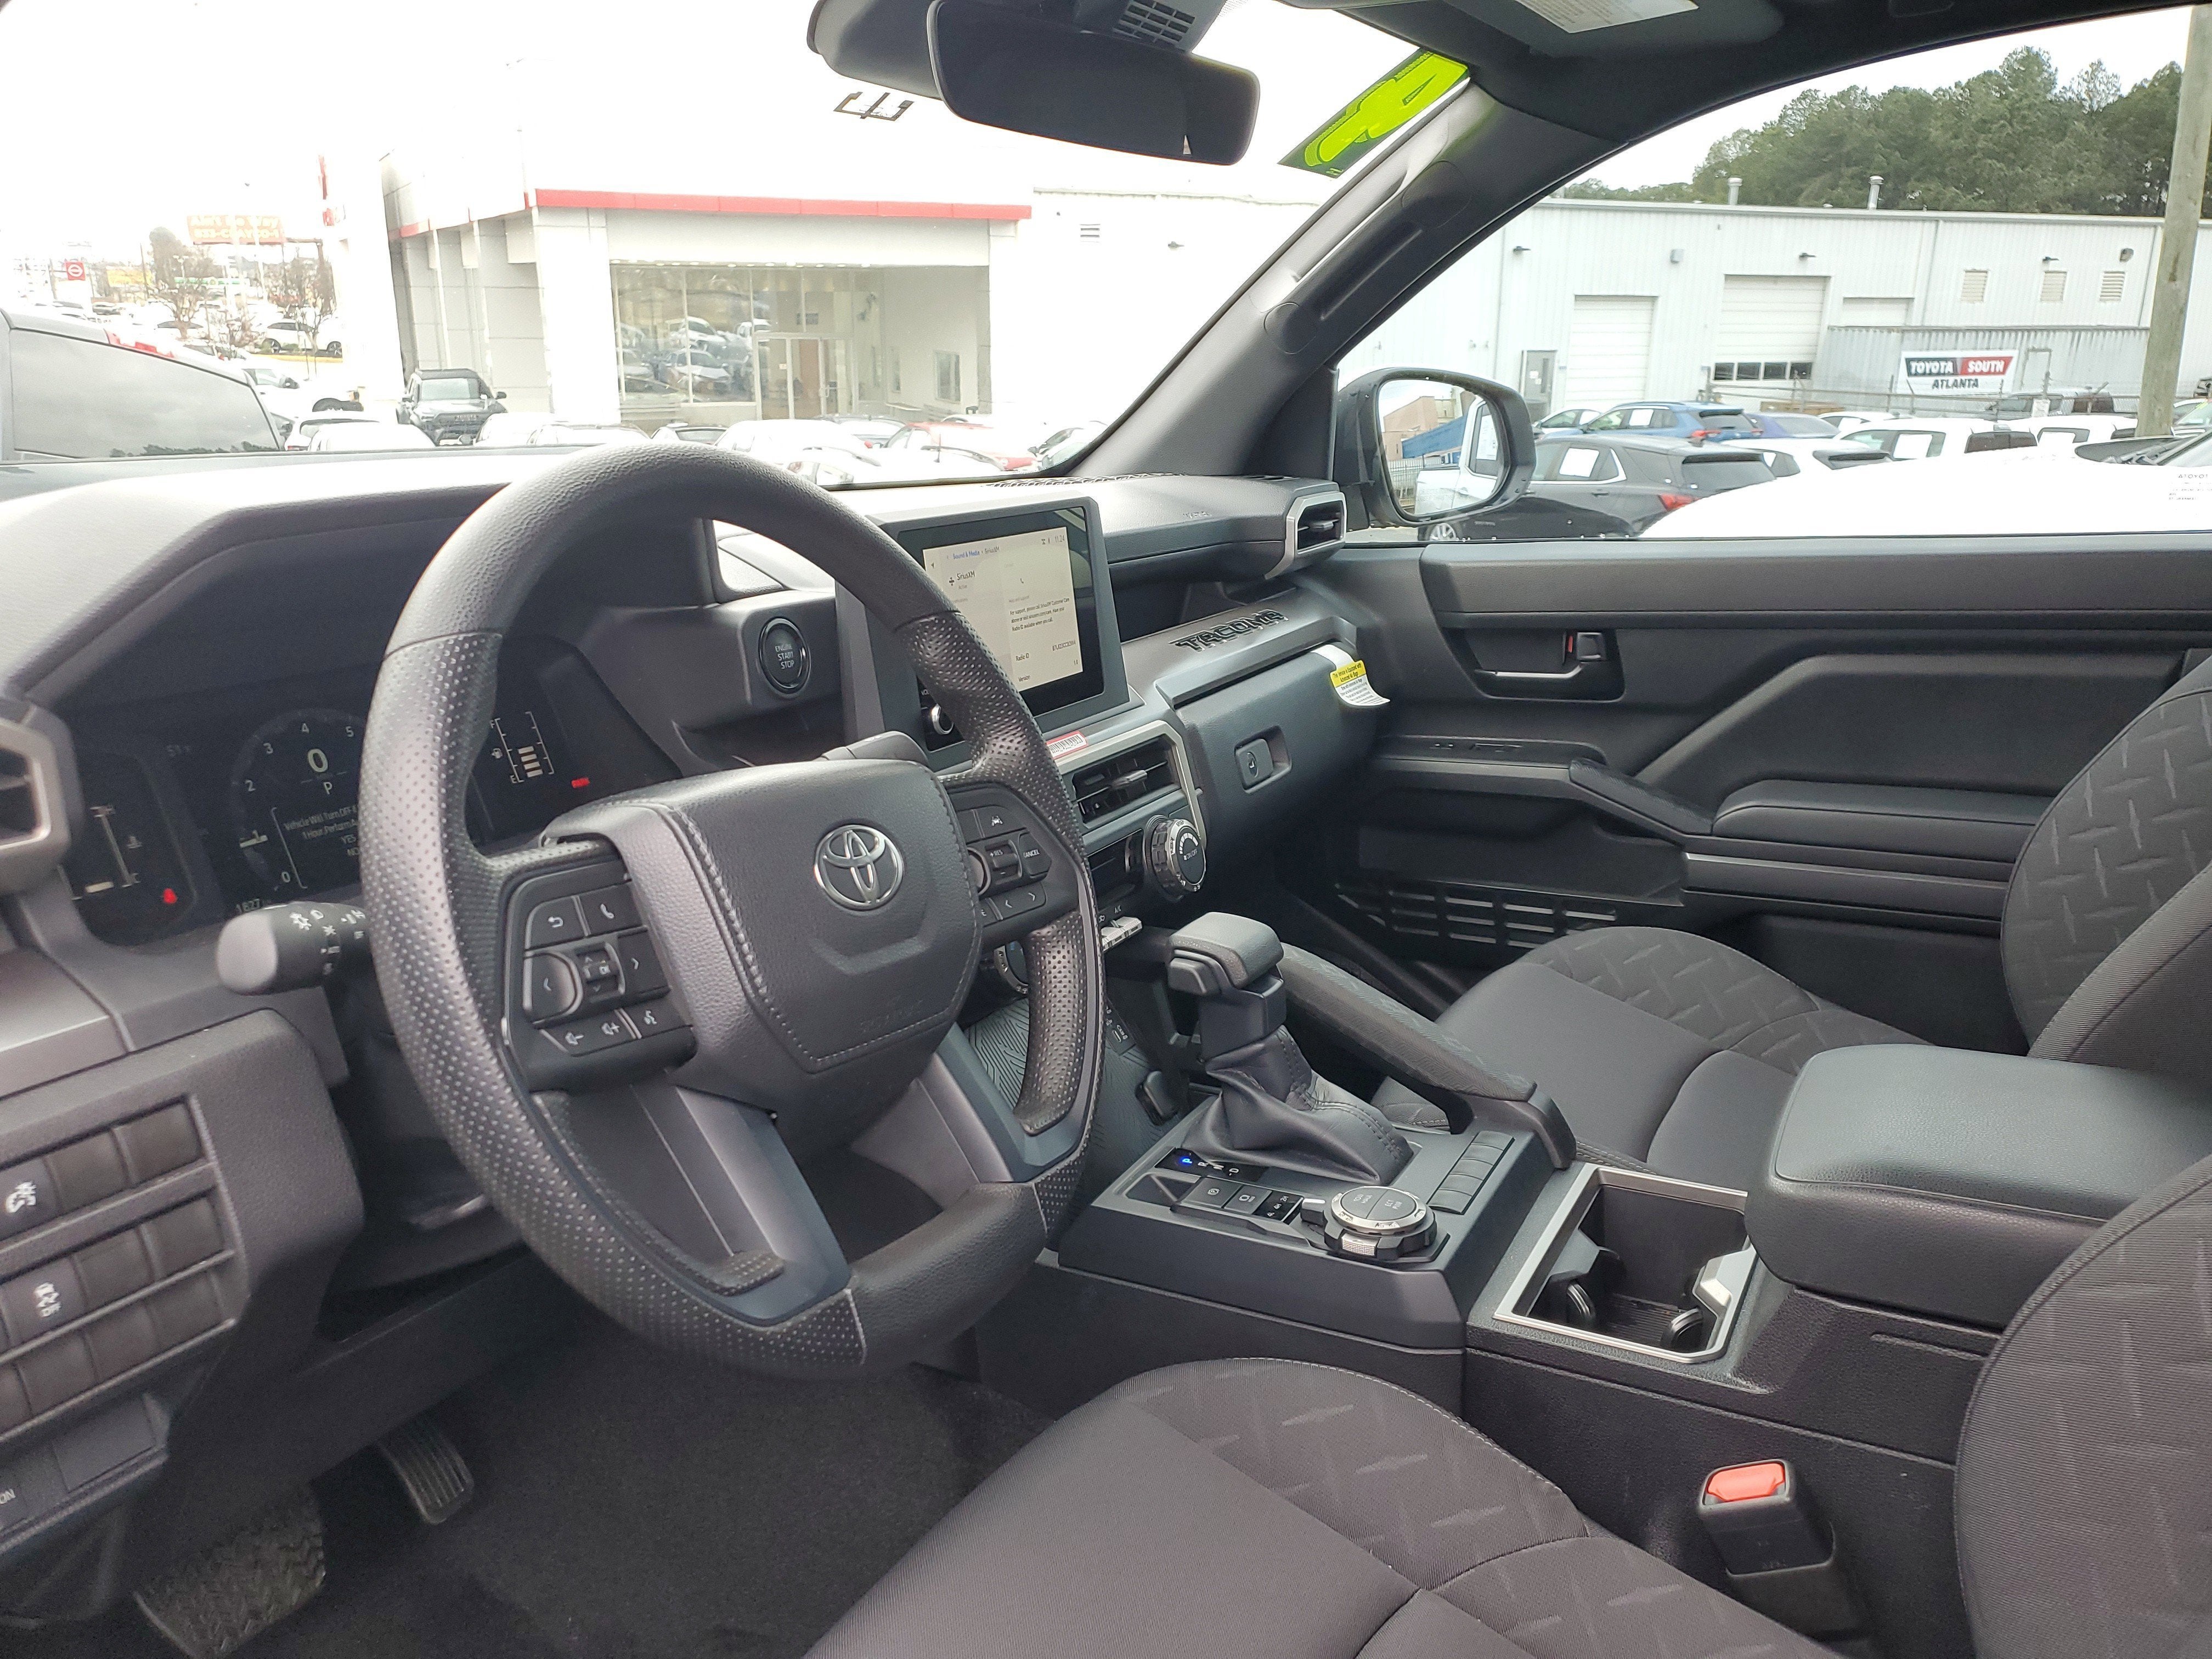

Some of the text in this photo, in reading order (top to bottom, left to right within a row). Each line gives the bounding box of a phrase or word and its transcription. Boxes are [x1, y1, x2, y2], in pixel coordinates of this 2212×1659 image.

[1910, 359, 2006, 375] TOYOTA SOUTH
[1931, 378, 1979, 391] ATLANTA
[957, 570, 975, 580] SiriusXM
[1169, 608, 1289, 652] TACOMA
[777, 651, 794, 661] START
[781, 660, 794, 669] STOP
[302, 723, 310, 733] 4
[346, 726, 354, 737] 5
[263, 743, 273, 754] 3
[307, 749, 329, 773] 0
[245, 780, 256, 792] 2
[323, 782, 332, 794] P
[281, 872, 291, 883] 0
